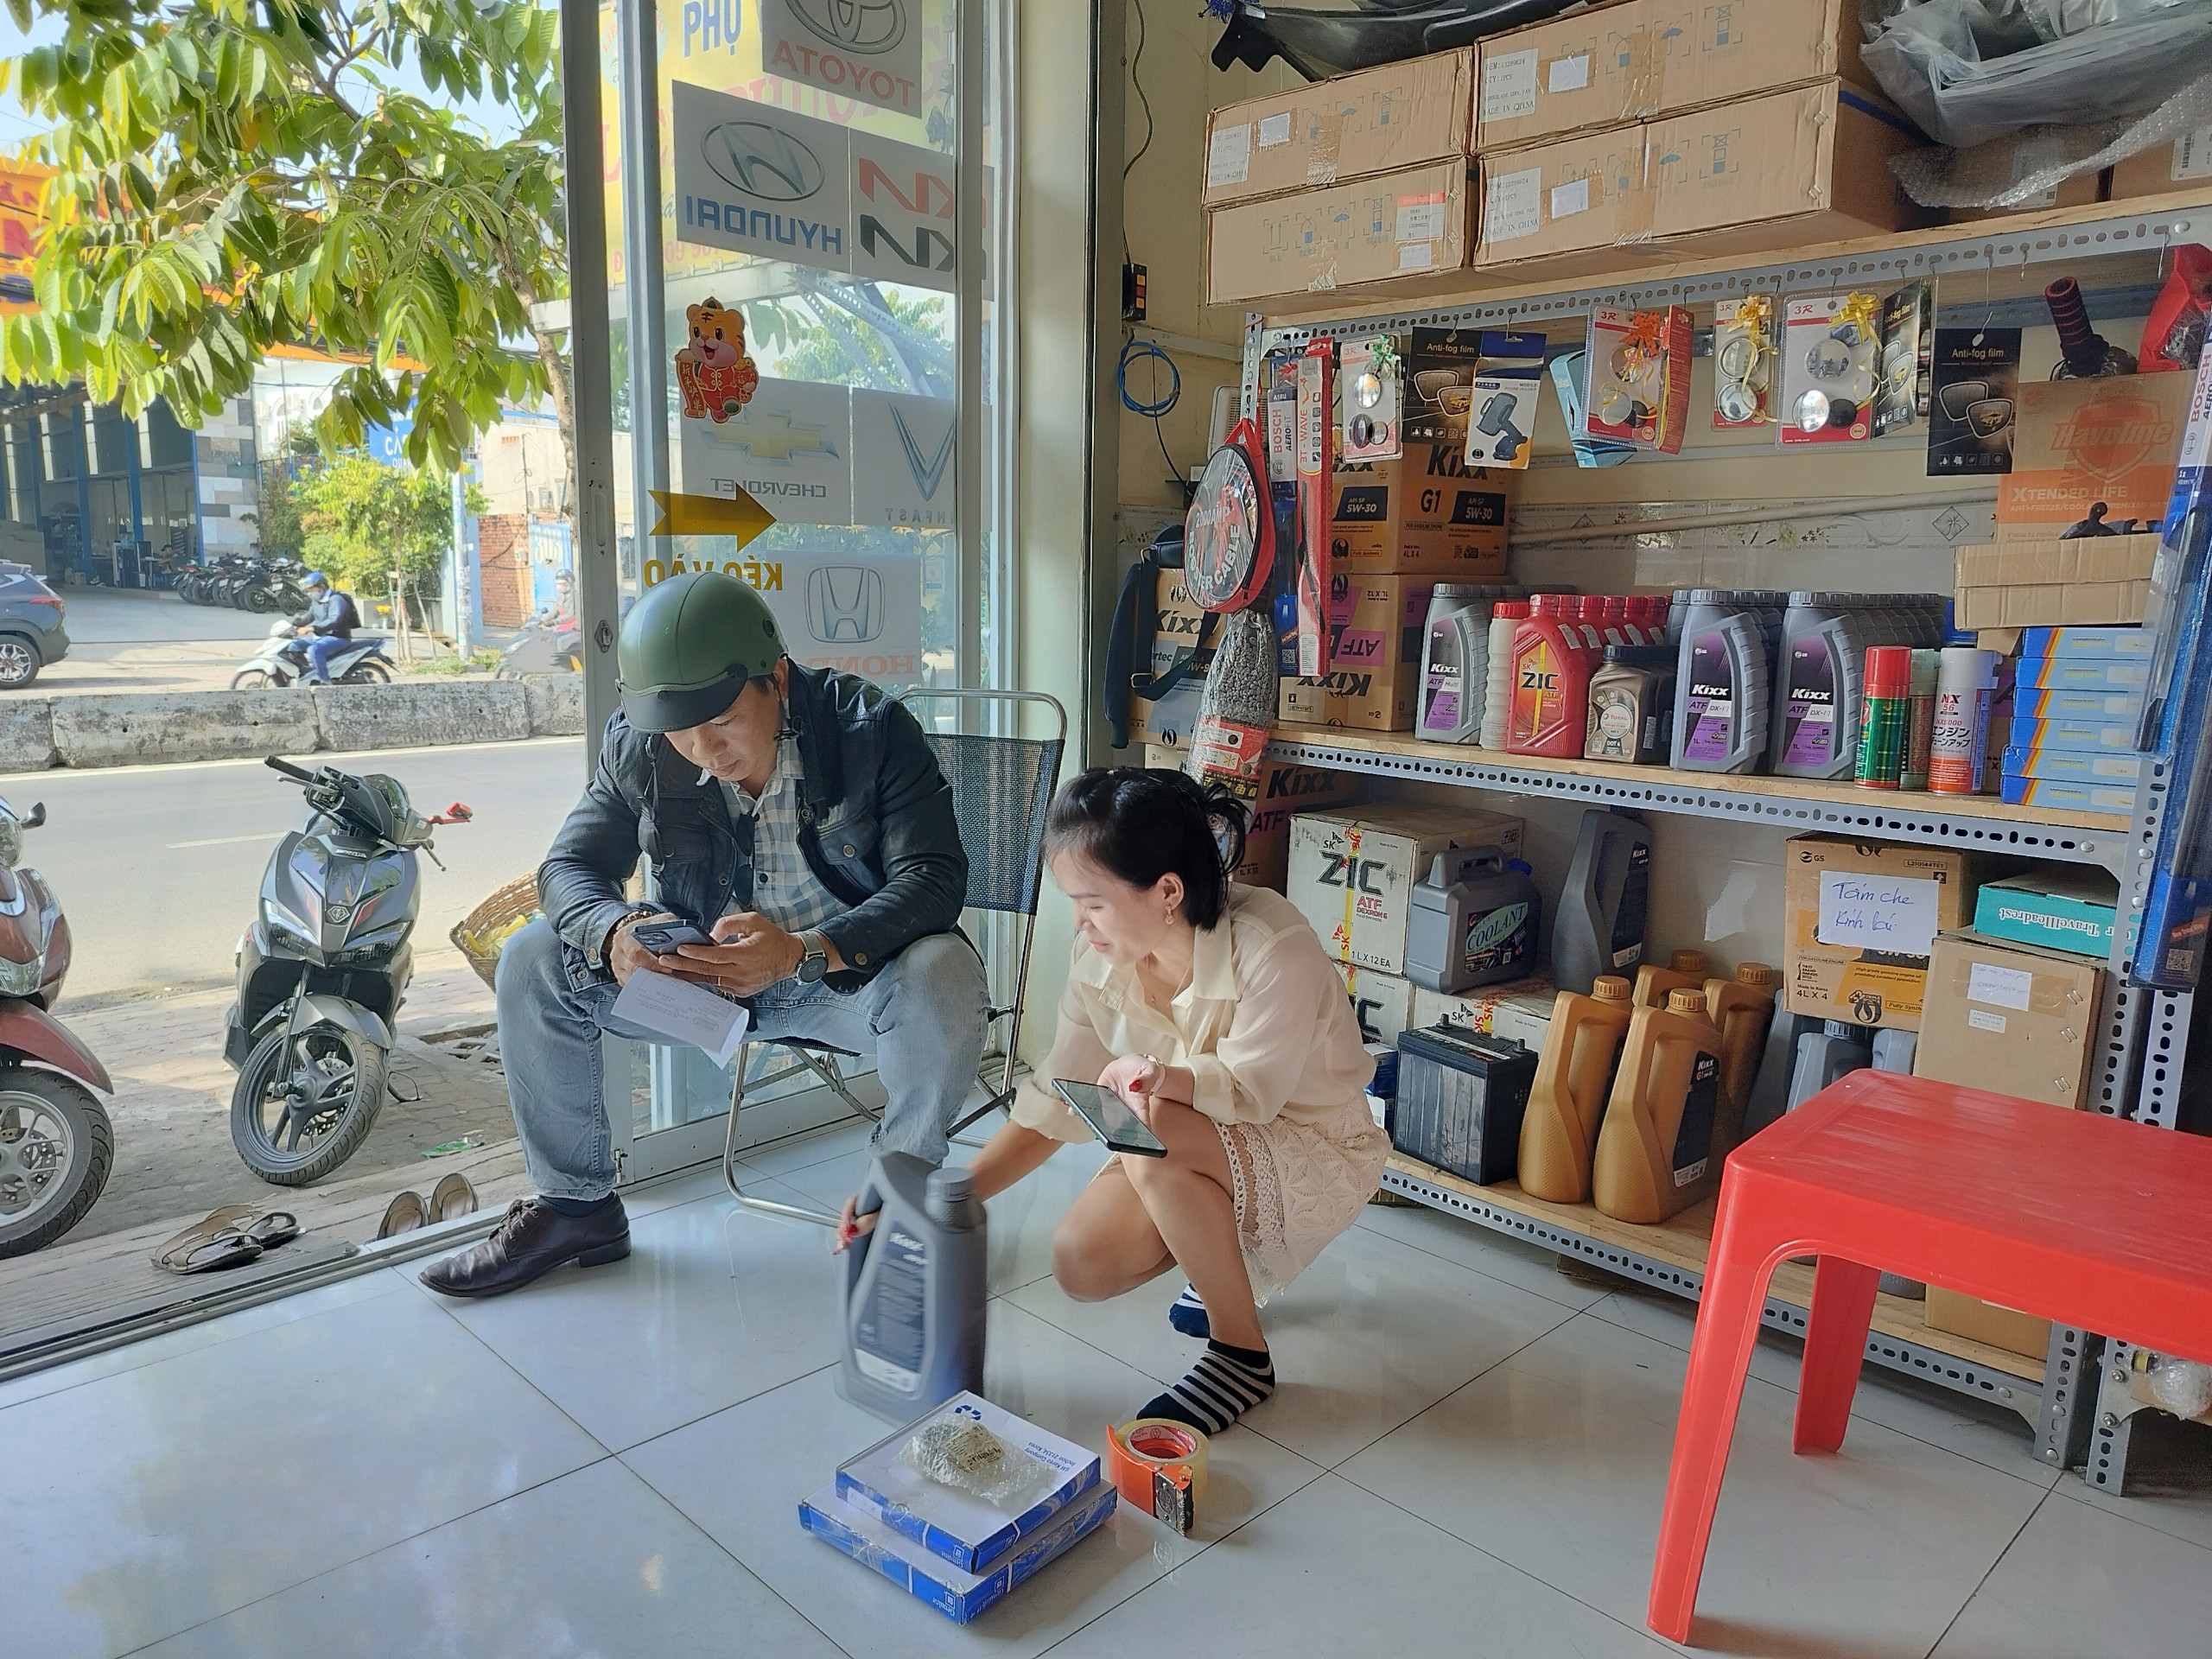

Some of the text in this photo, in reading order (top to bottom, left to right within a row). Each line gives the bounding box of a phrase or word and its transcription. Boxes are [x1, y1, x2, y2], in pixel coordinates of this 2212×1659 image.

[683, 0, 741, 58] PHỤ
[1518, 218, 1538, 230] CHINA
[1600, 311, 1617, 321] 3R
[1794, 304, 1814, 315] 3R
[1427, 342, 1475, 354] Anti-fog film
[1951, 347, 2005, 360] Anti-fog film
[2190, 353, 2212, 423] BOSCH
[1272, 409, 1283, 454] BOSCH
[1420, 488, 1441, 513] G1
[2012, 486, 2128, 503] XTENDED LIFE
[1346, 503, 1377, 513] 5W-30
[1465, 506, 1493, 520] 5W-30
[2011, 502, 2093, 512] ANTI-FREEZE/COOLA
[1213, 524, 1242, 585] CABLE
[1340, 638, 1381, 657] ATF
[1430, 663, 1460, 674] Kixx
[1295, 671, 1373, 697] Kixx
[1521, 671, 1560, 690] ZIC
[1691, 683, 1730, 696] Kixx
[1791, 688, 1831, 701] Kixx
[1689, 701, 1707, 709] ATF
[1941, 693, 1962, 705] NX
[1266, 767, 1336, 799] Kixx
[1249, 809, 1287, 835] ATF
[1323, 839, 1336, 850] SK
[335, 849, 367, 859] HONDA
[1632, 849, 1647, 859] Kixx
[1814, 854, 1825, 862] GS
[1315, 849, 1388, 898] ZIC
[1357, 895, 1382, 910] ATF
[1879, 887, 1916, 905] che
[1467, 904, 1528, 950] COOLANT
[1341, 936, 1351, 950] SK
[1370, 954, 1379, 964] 12
[1380, 957, 1391, 968] EA
[1796, 989, 1809, 998] 4L
[1821, 992, 1828, 1001] 4
[1452, 1012, 1465, 1022] SK
[1698, 1058, 1714, 1071] Kixx
[1028, 1441, 1042, 1452] Korea
[1023, 1447, 1046, 1463] Company
[1046, 1458, 1059, 1469] Korea
[940, 1550, 963, 1568] Genuine
[932, 1597, 956, 1617] Genuine
